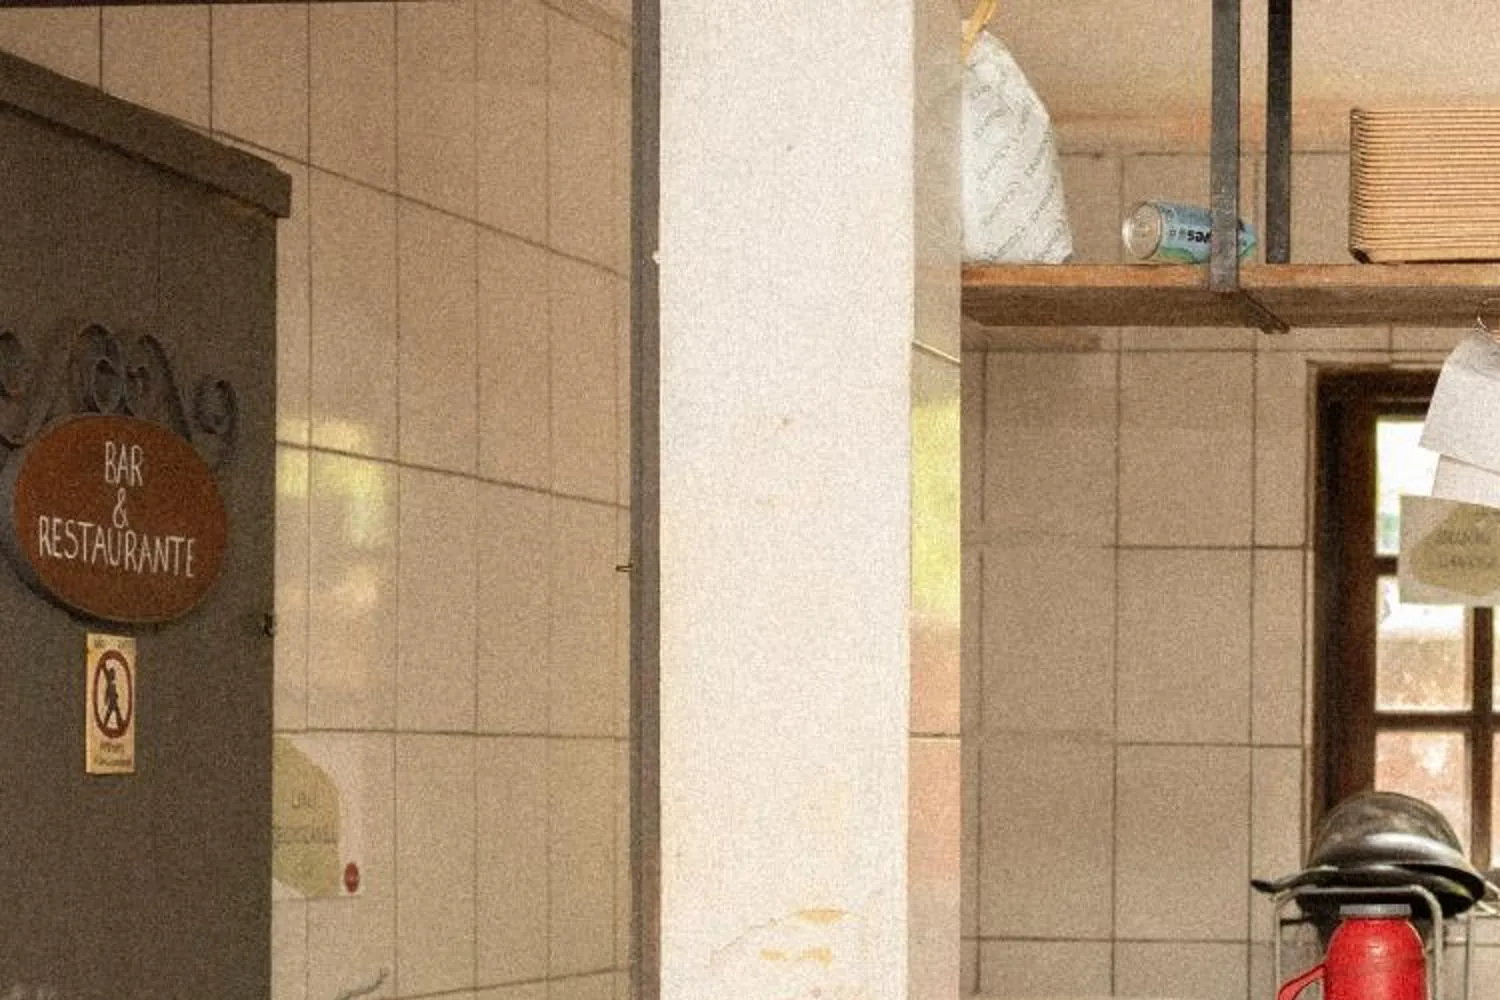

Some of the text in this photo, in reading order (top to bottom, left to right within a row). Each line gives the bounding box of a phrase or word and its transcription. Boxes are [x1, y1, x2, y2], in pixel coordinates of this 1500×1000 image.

[105, 440, 143, 486] BAR
[112, 487, 128, 528] &
[39, 515, 196, 577] RESTAURANTE
